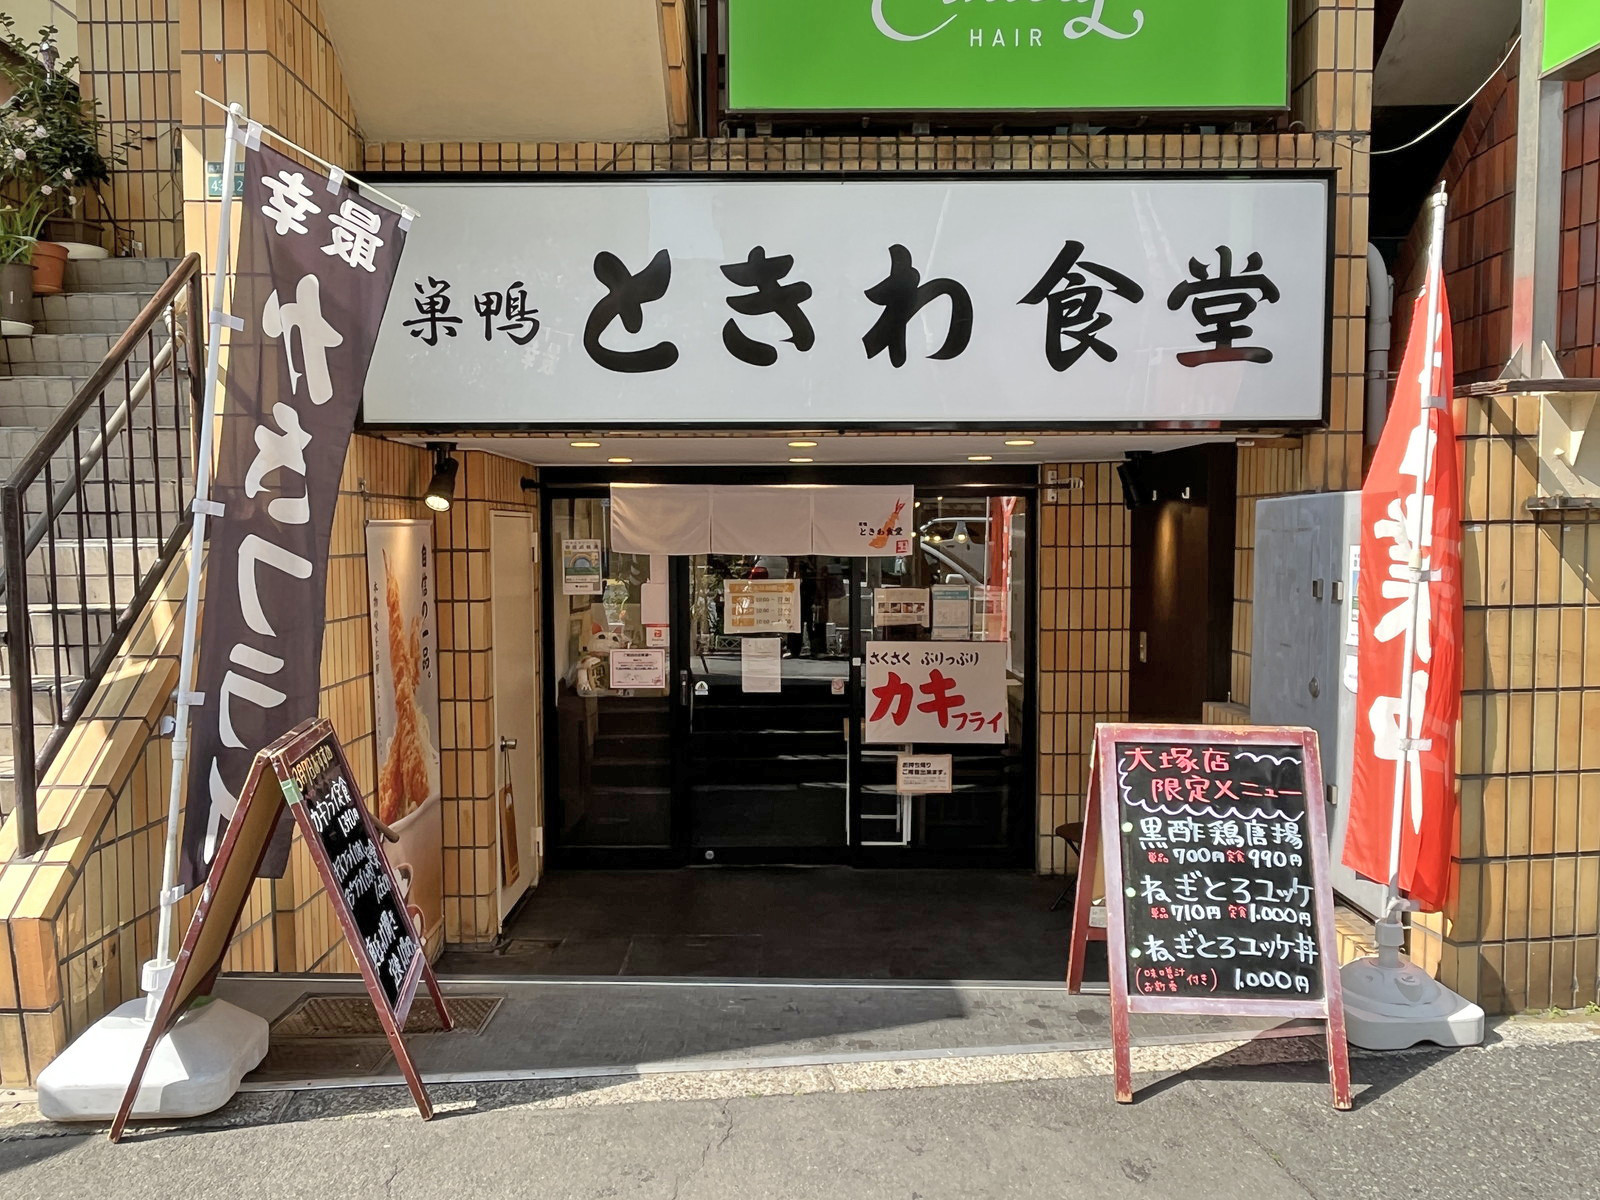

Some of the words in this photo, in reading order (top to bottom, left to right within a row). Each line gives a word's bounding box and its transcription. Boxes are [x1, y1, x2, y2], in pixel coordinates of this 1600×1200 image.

[969, 28, 1042, 47] HAIR
[402, 275, 540, 347] 巣鴨
[583, 239, 1280, 373] ときわ食堂
[869, 651, 911, 666] さくさく
[1124, 746, 1231, 774] 大塚店
[1151, 774, 1303, 803] 限定メニュー
[311, 776, 351, 833] カキフライ定食
[1138, 816, 1304, 850] 黒酢鶏唐揚
[1172, 847, 1225, 864] 700円
[1247, 849, 1303, 869] 990円
[1140, 870, 1314, 908] ねぎとろユッケ
[1171, 904, 1222, 922] 710円
[1143, 928, 1319, 965] ねぎとろユッケ丼
